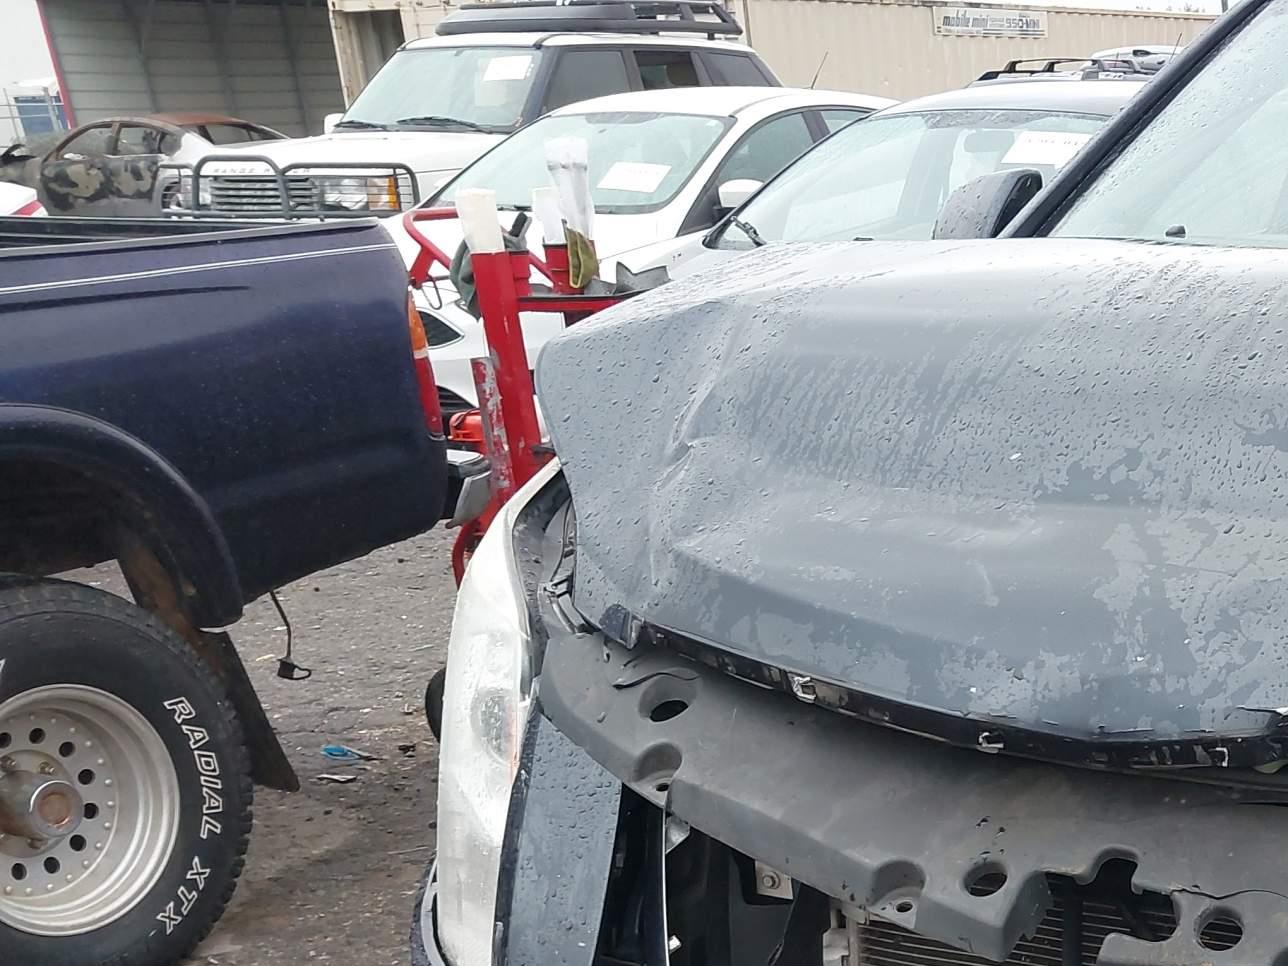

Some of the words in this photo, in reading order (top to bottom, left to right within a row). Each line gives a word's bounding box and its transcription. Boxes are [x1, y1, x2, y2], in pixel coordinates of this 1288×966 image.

[942, 9, 971, 28] mobile
[971, 14, 989, 28] mini
[163, 696, 224, 840] RADIAL
[155, 855, 211, 936] XTX
